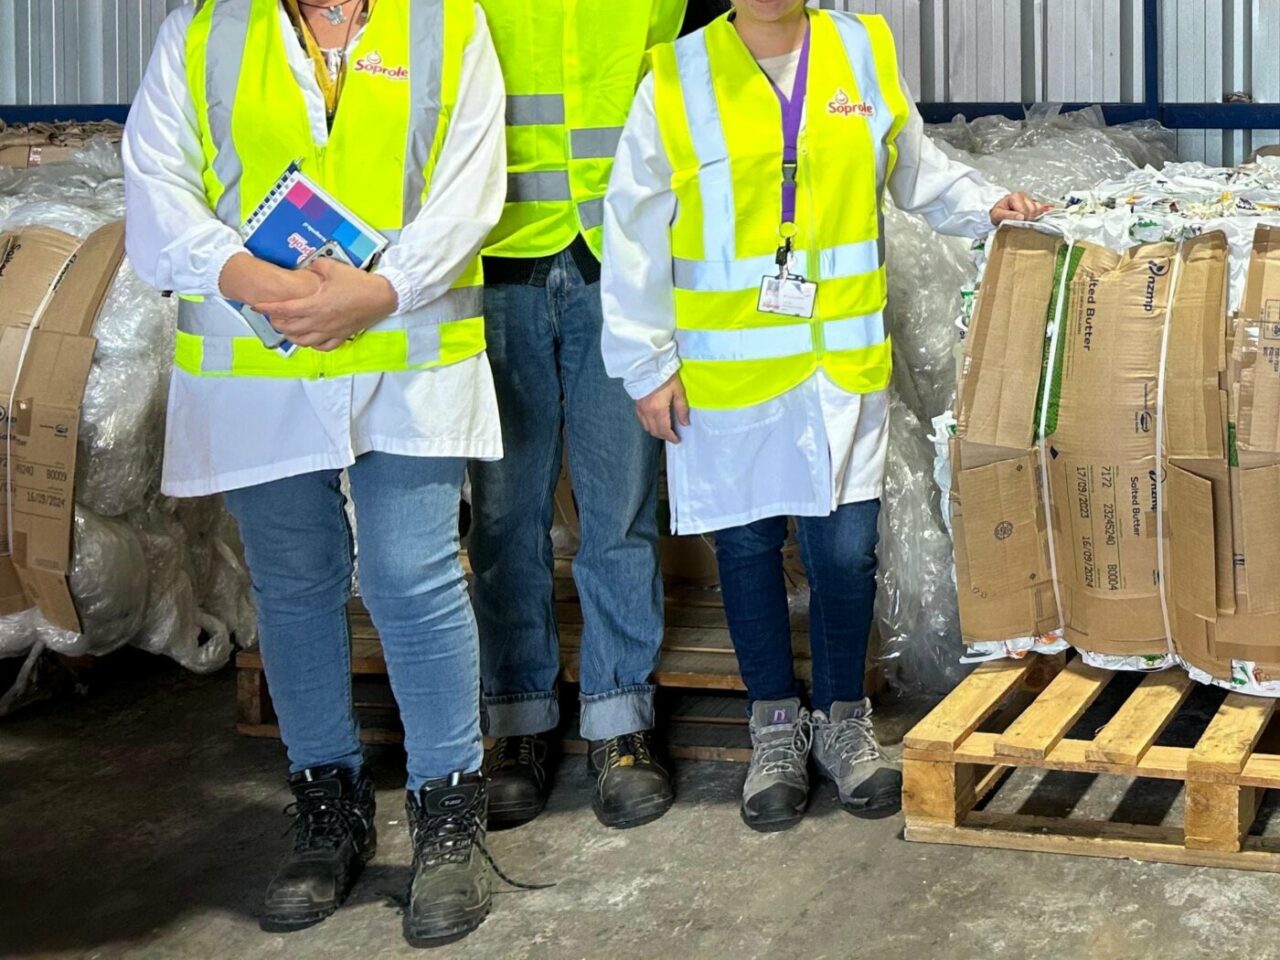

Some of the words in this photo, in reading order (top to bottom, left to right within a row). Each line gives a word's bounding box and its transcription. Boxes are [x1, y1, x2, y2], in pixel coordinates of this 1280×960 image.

[355, 59, 408, 78] Soprole
[828, 102, 873, 116] Soprole
[1087, 275, 1099, 304] lted
[1143, 276, 1156, 312] nzmp
[1083, 307, 1096, 351] Butter
[1101, 465, 1112, 488] 7172
[1130, 476, 1140, 506] Salted
[1076, 466, 1089, 519] 17/09/2023
[1103, 503, 1116, 546] 23245240
[1132, 507, 1141, 537] Butter
[1082, 536, 1094, 589] 16/09/2024
[1107, 564, 1119, 591] B0004
